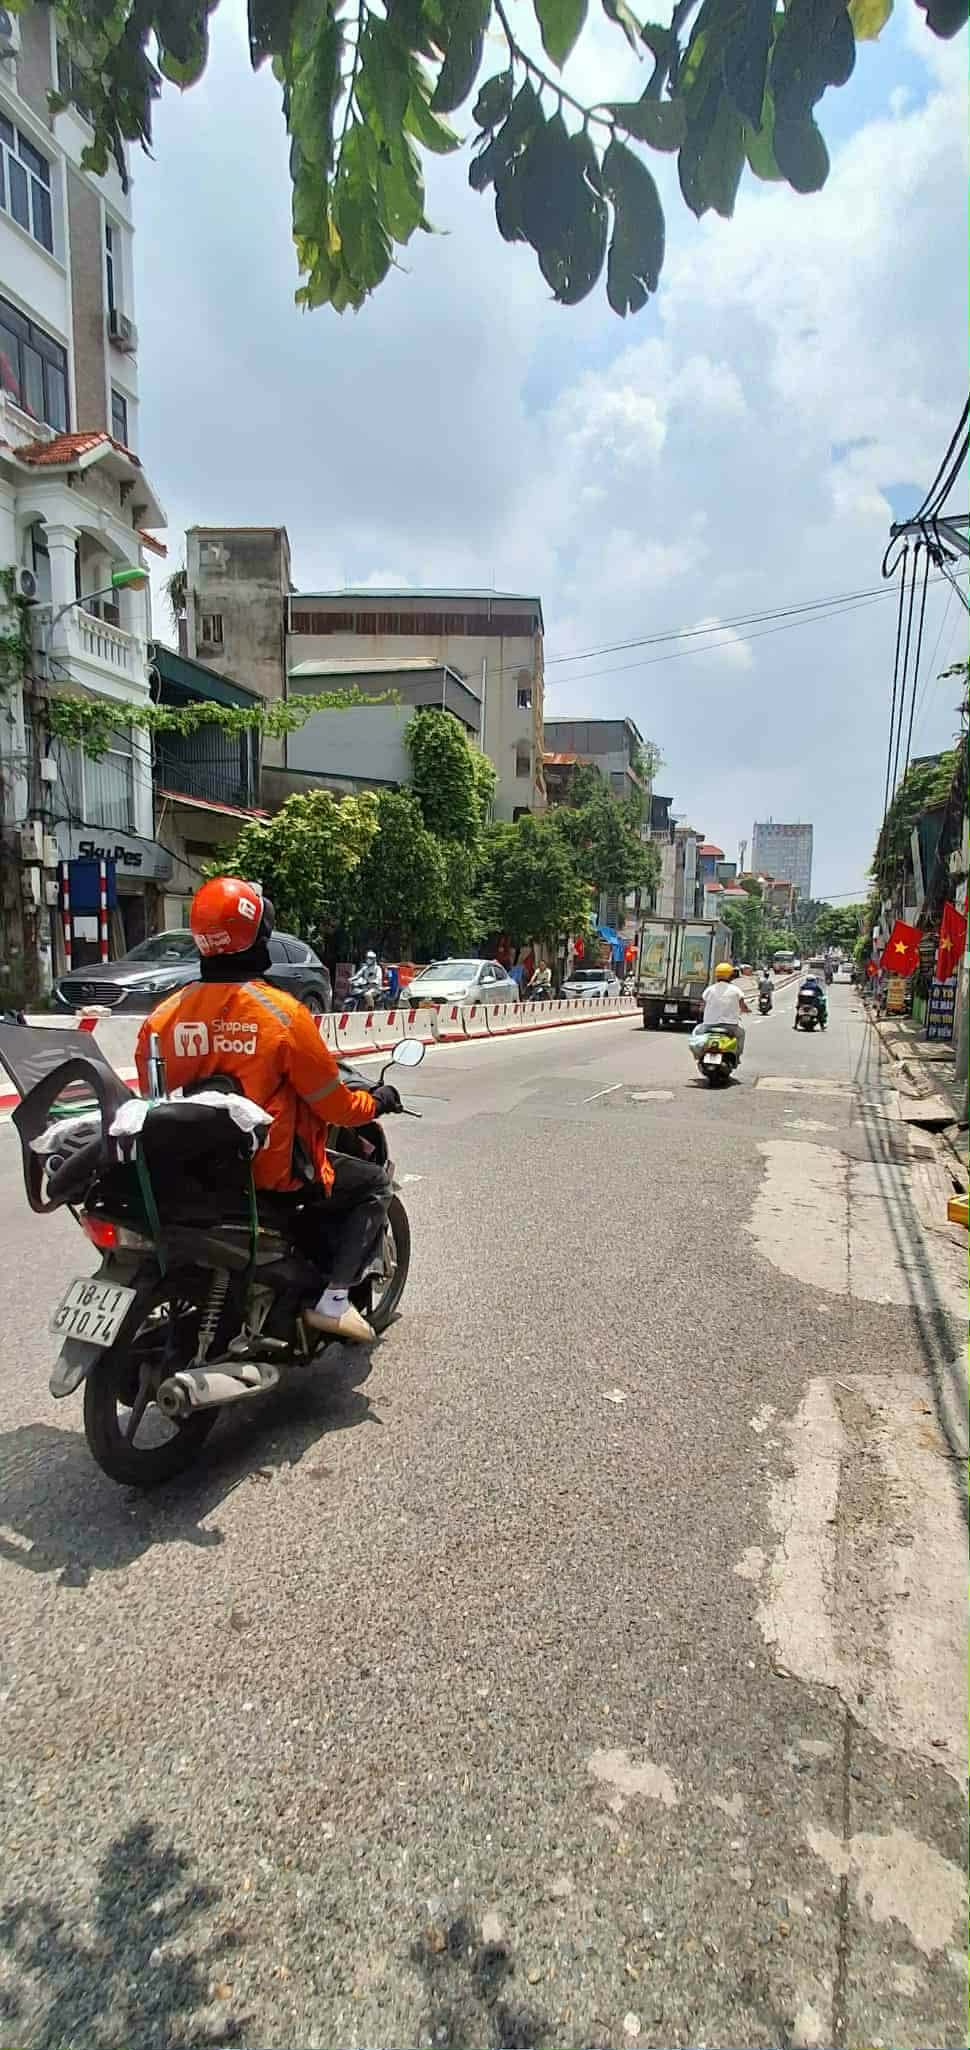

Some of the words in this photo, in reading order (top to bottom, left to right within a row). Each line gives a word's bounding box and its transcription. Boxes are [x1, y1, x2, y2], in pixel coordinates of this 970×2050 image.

[212, 1018, 258, 1035] Shopee
[213, 1035, 257, 1055] Food
[77, 1284, 122, 1312] 18-L1
[54, 1306, 115, 1341] 310.74
